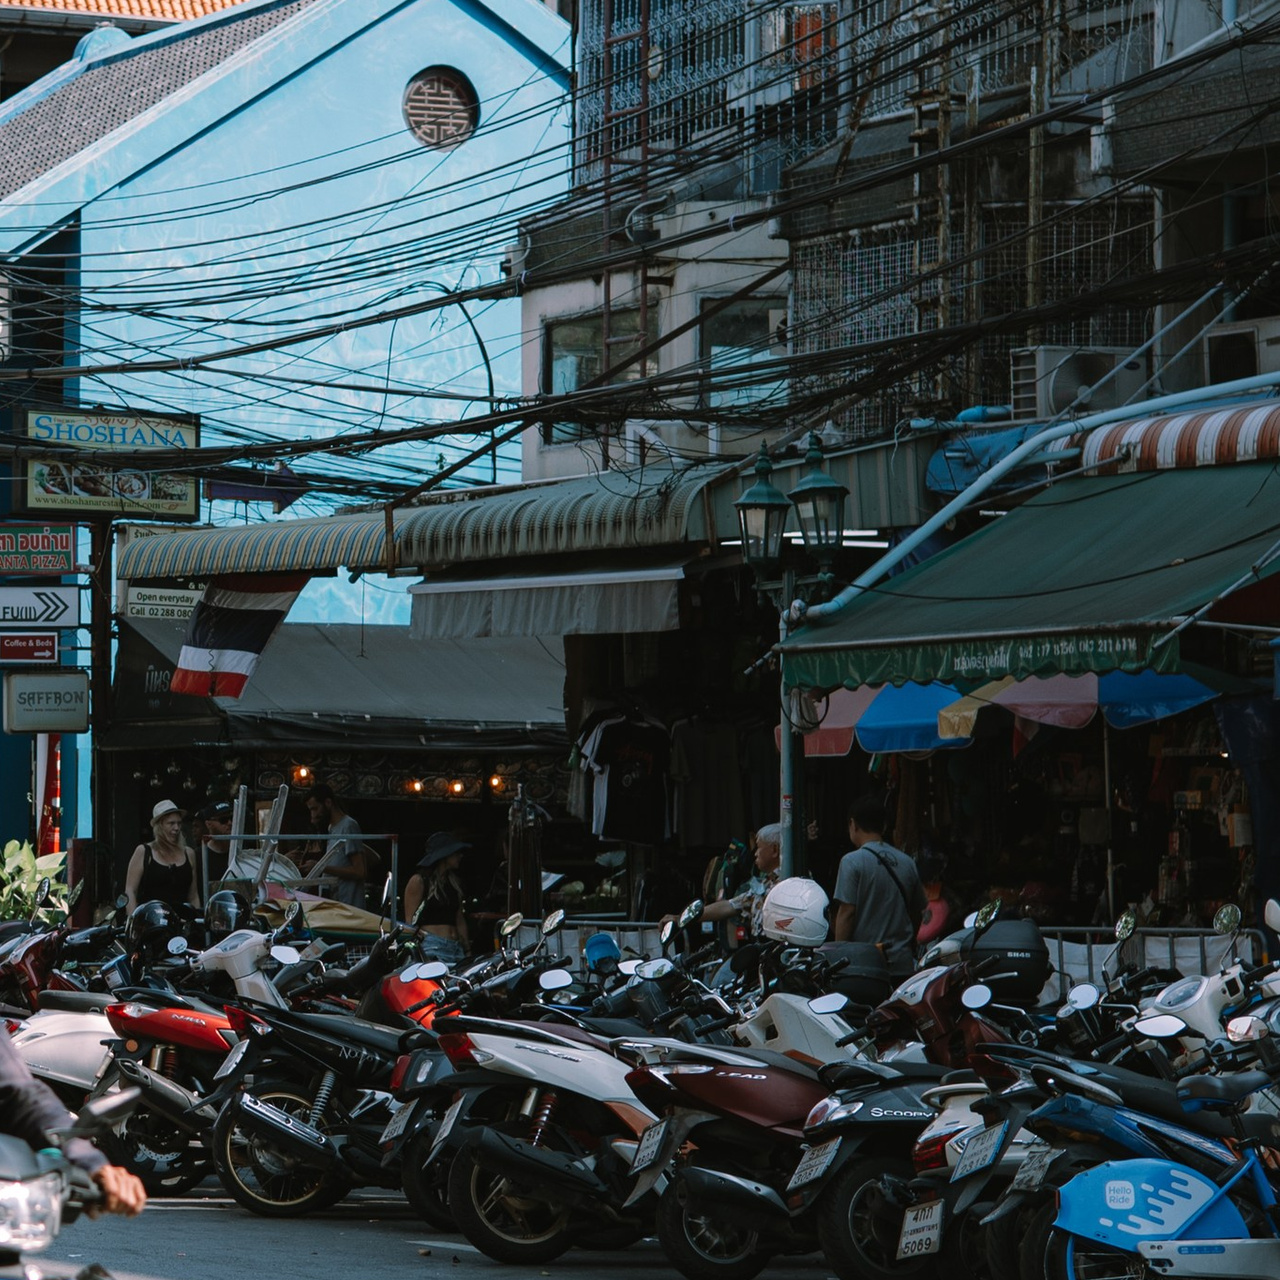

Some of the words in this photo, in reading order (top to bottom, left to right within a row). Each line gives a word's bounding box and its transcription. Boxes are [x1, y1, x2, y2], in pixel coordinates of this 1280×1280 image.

[34, 415, 188, 447] SHOSHANA
[18, 526, 71, 552] อบถ่าน
[30, 554, 68, 570] PIZZA
[136, 592, 158, 603] Open
[159, 593, 195, 605] everyday
[130, 606, 146, 616] Call
[148, 607, 159, 617] 02
[160, 607, 175, 618] 288
[176, 608, 193, 618] 080
[4, 639, 28, 648] Coffee
[28, 639, 35, 647] &
[35, 639, 53, 648] Beds
[16, 690, 85, 708] SAFFRON
[1108, 1186, 1132, 1195] Hello
[1108, 1195, 1130, 1204] Ride
[902, 1236, 932, 1255] 5069
